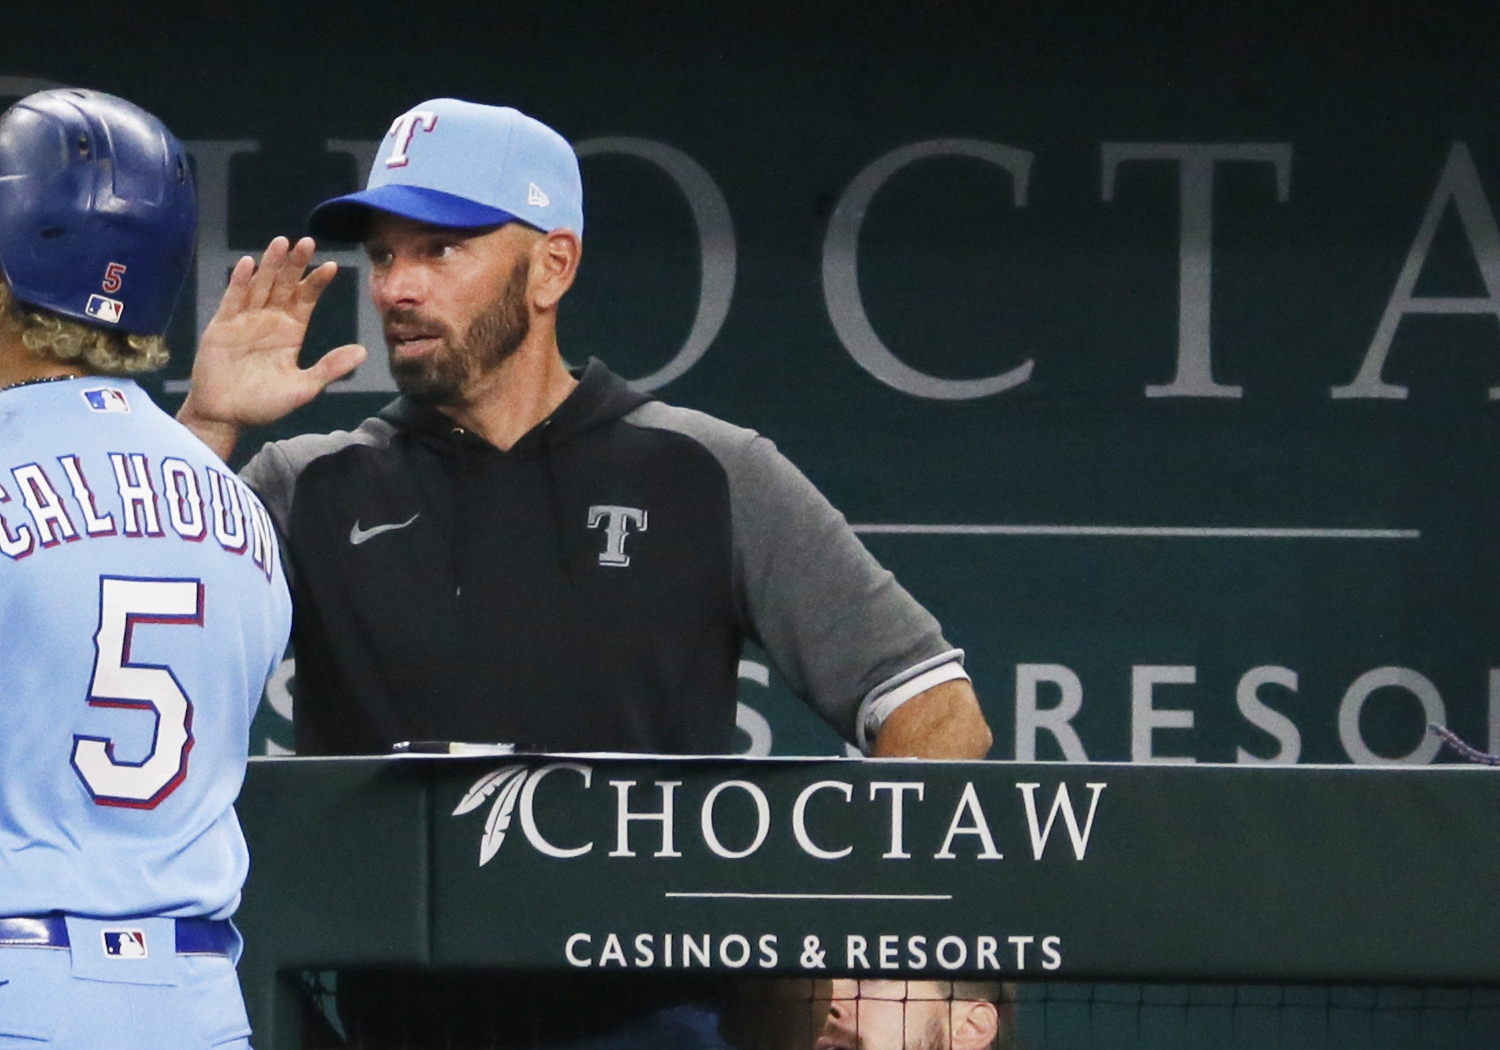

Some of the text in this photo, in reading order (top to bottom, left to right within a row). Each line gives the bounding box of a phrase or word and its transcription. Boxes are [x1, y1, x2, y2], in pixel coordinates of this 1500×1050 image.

[385, 111, 438, 169] T
[102, 262, 127, 293] 5
[587, 505, 648, 567] T
[70, 575, 205, 810] 5
[1014, 663, 1500, 766] RESO
[518, 763, 1107, 861] CHOCTAW
[565, 932, 1063, 971] CASINOS & RESORTS
